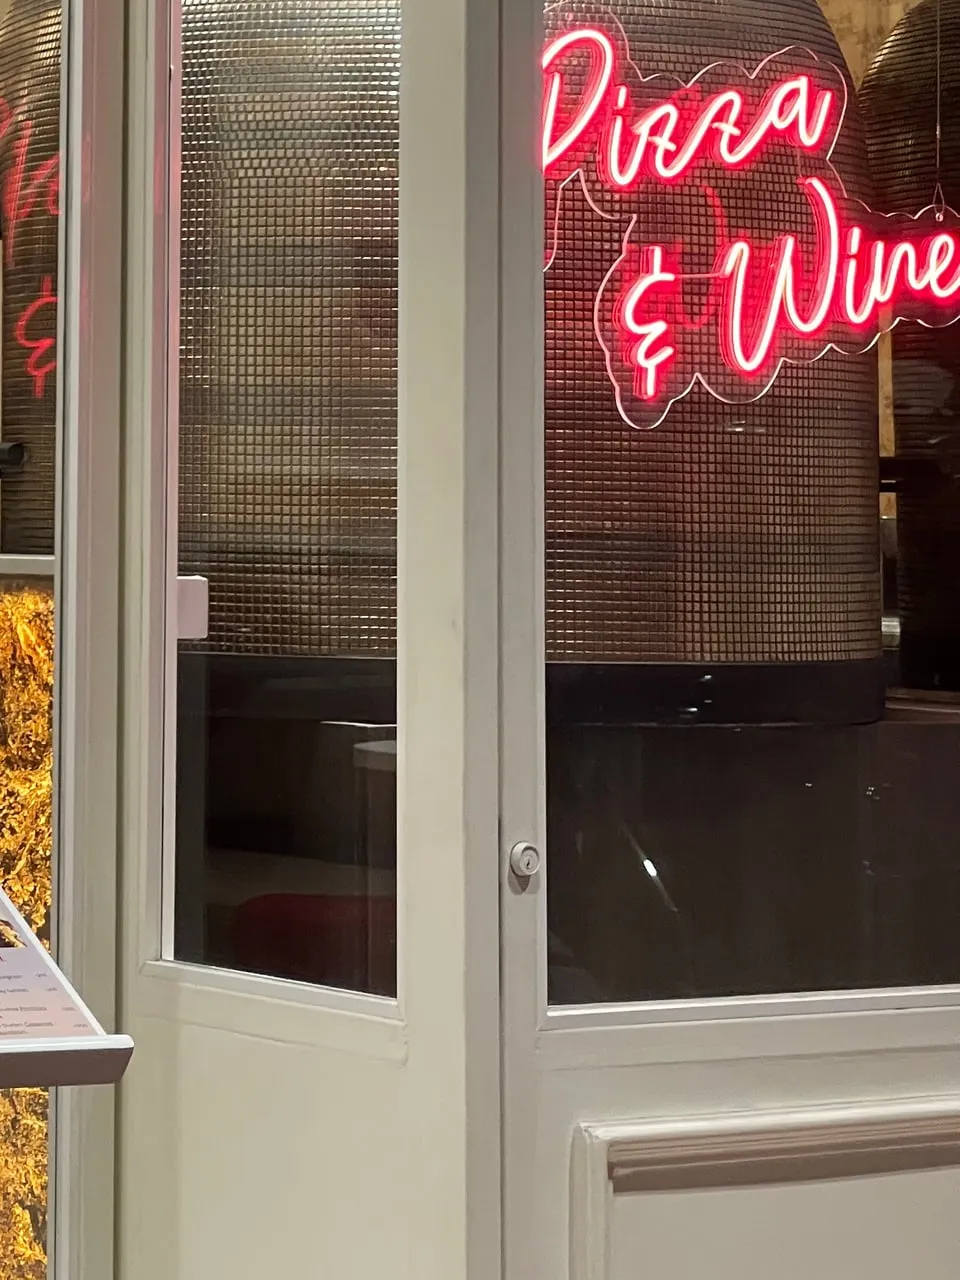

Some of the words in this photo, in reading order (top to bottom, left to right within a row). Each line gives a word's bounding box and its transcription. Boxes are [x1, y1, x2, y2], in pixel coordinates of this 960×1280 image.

[542, 28, 835, 187] Pizza
[614, 245, 676, 401] &
[721, 175, 960, 373] Wine
